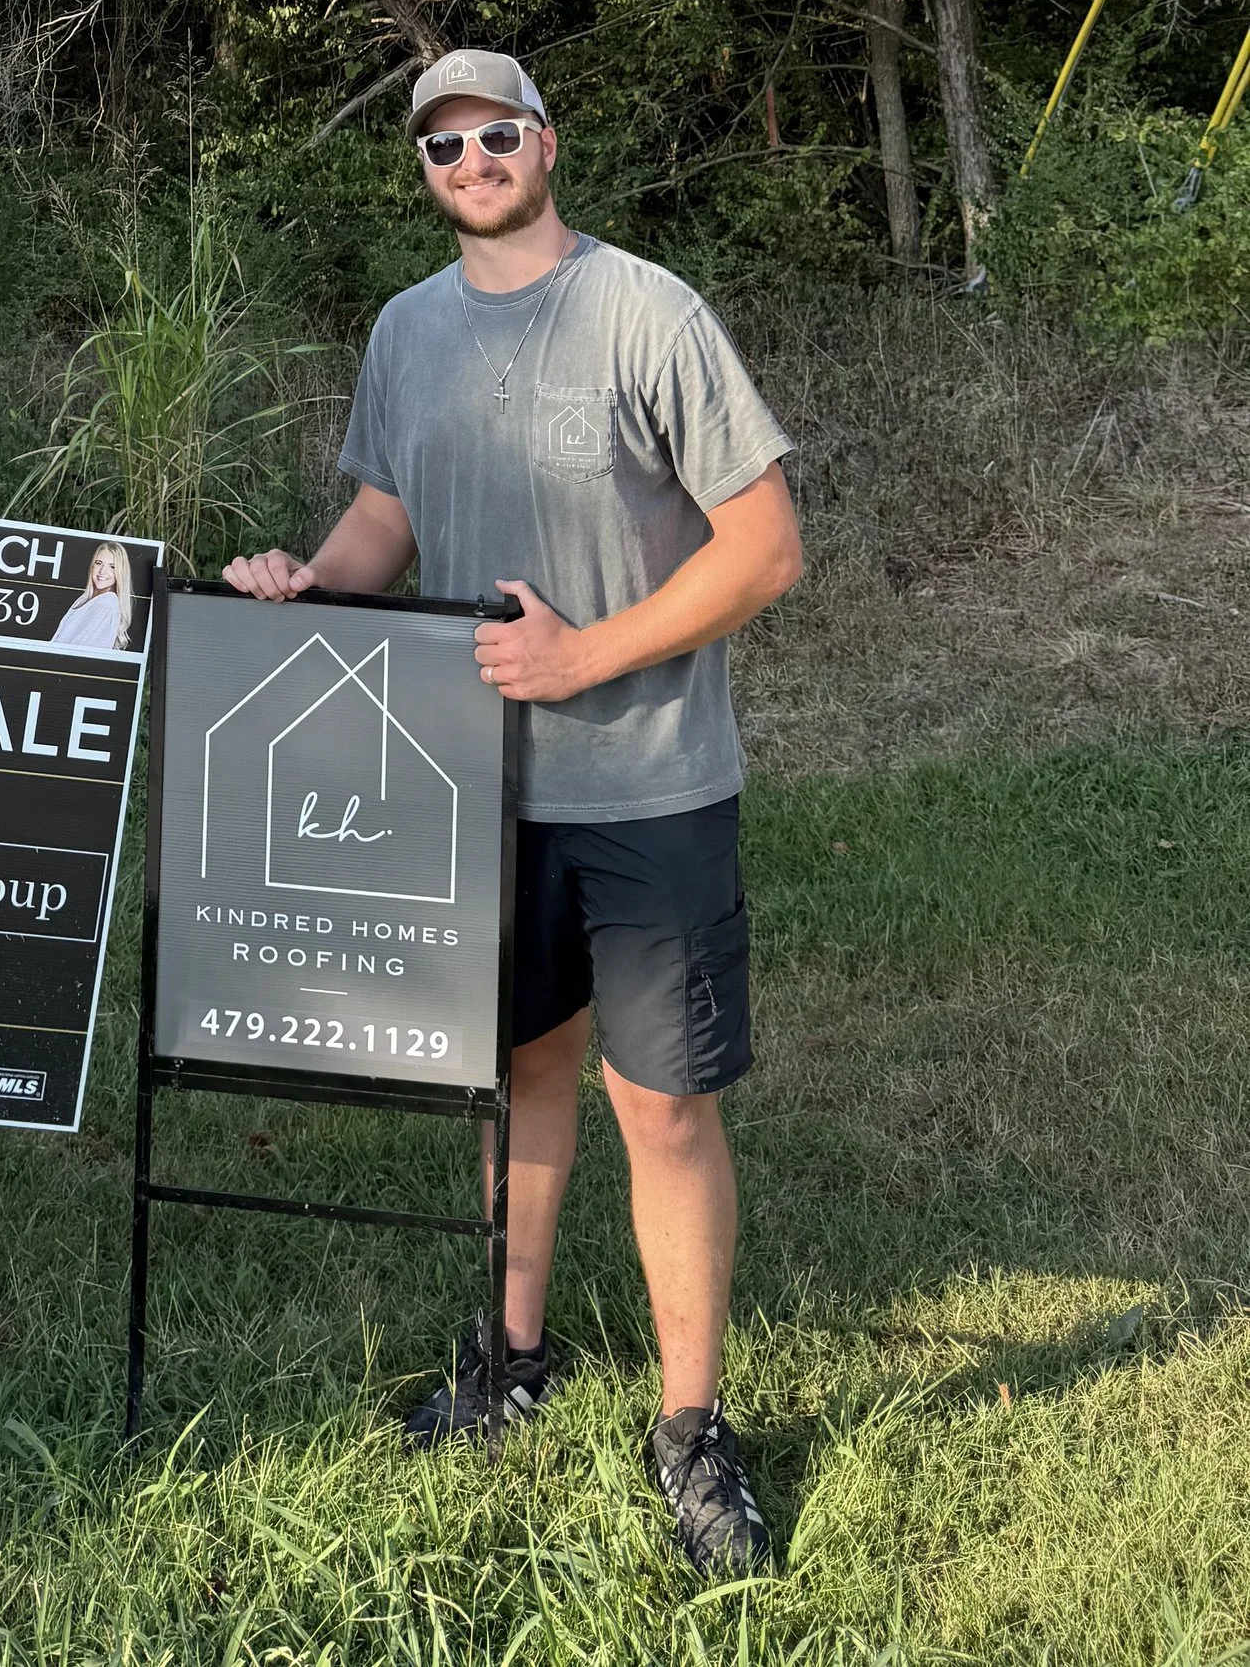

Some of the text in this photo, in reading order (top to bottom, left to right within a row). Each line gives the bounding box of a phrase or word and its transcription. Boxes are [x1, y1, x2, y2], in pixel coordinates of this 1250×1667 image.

[196, 905, 459, 946] KINDRED HOMES
[232, 942, 405, 976] ROOFING
[200, 1008, 449, 1059] 479.222.1129
